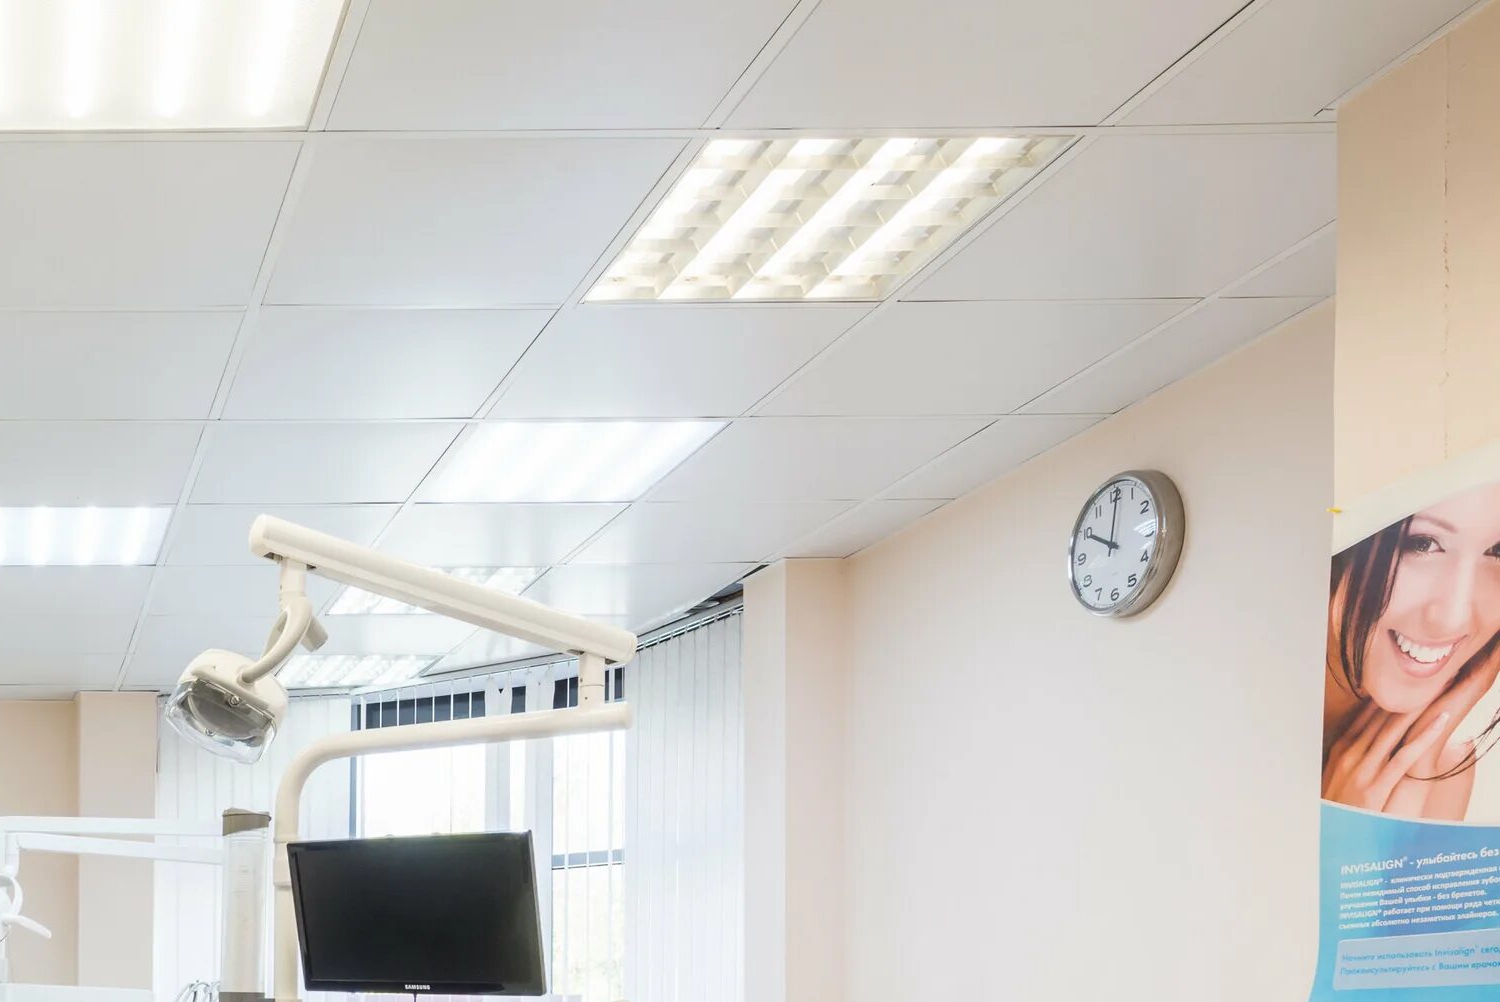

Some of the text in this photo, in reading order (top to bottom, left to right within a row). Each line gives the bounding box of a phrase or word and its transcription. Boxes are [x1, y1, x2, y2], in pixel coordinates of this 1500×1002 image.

[1109, 487, 1122, 504] 12
[1095, 505, 1102, 519] 11
[1139, 500, 1150, 514] 2
[1083, 526, 1093, 541] 10
[1077, 553, 1087, 566] 9
[1140, 550, 1149, 563] 4
[1083, 574, 1093, 588] 8
[1127, 573, 1138, 588] 5
[1095, 587, 1103, 601] 7
[1110, 588, 1120, 601] 6
[1416, 852, 1478, 869] улыбайтесь
[1480, 847, 1499, 858] без
[1438, 962, 1470, 971] Вашим
